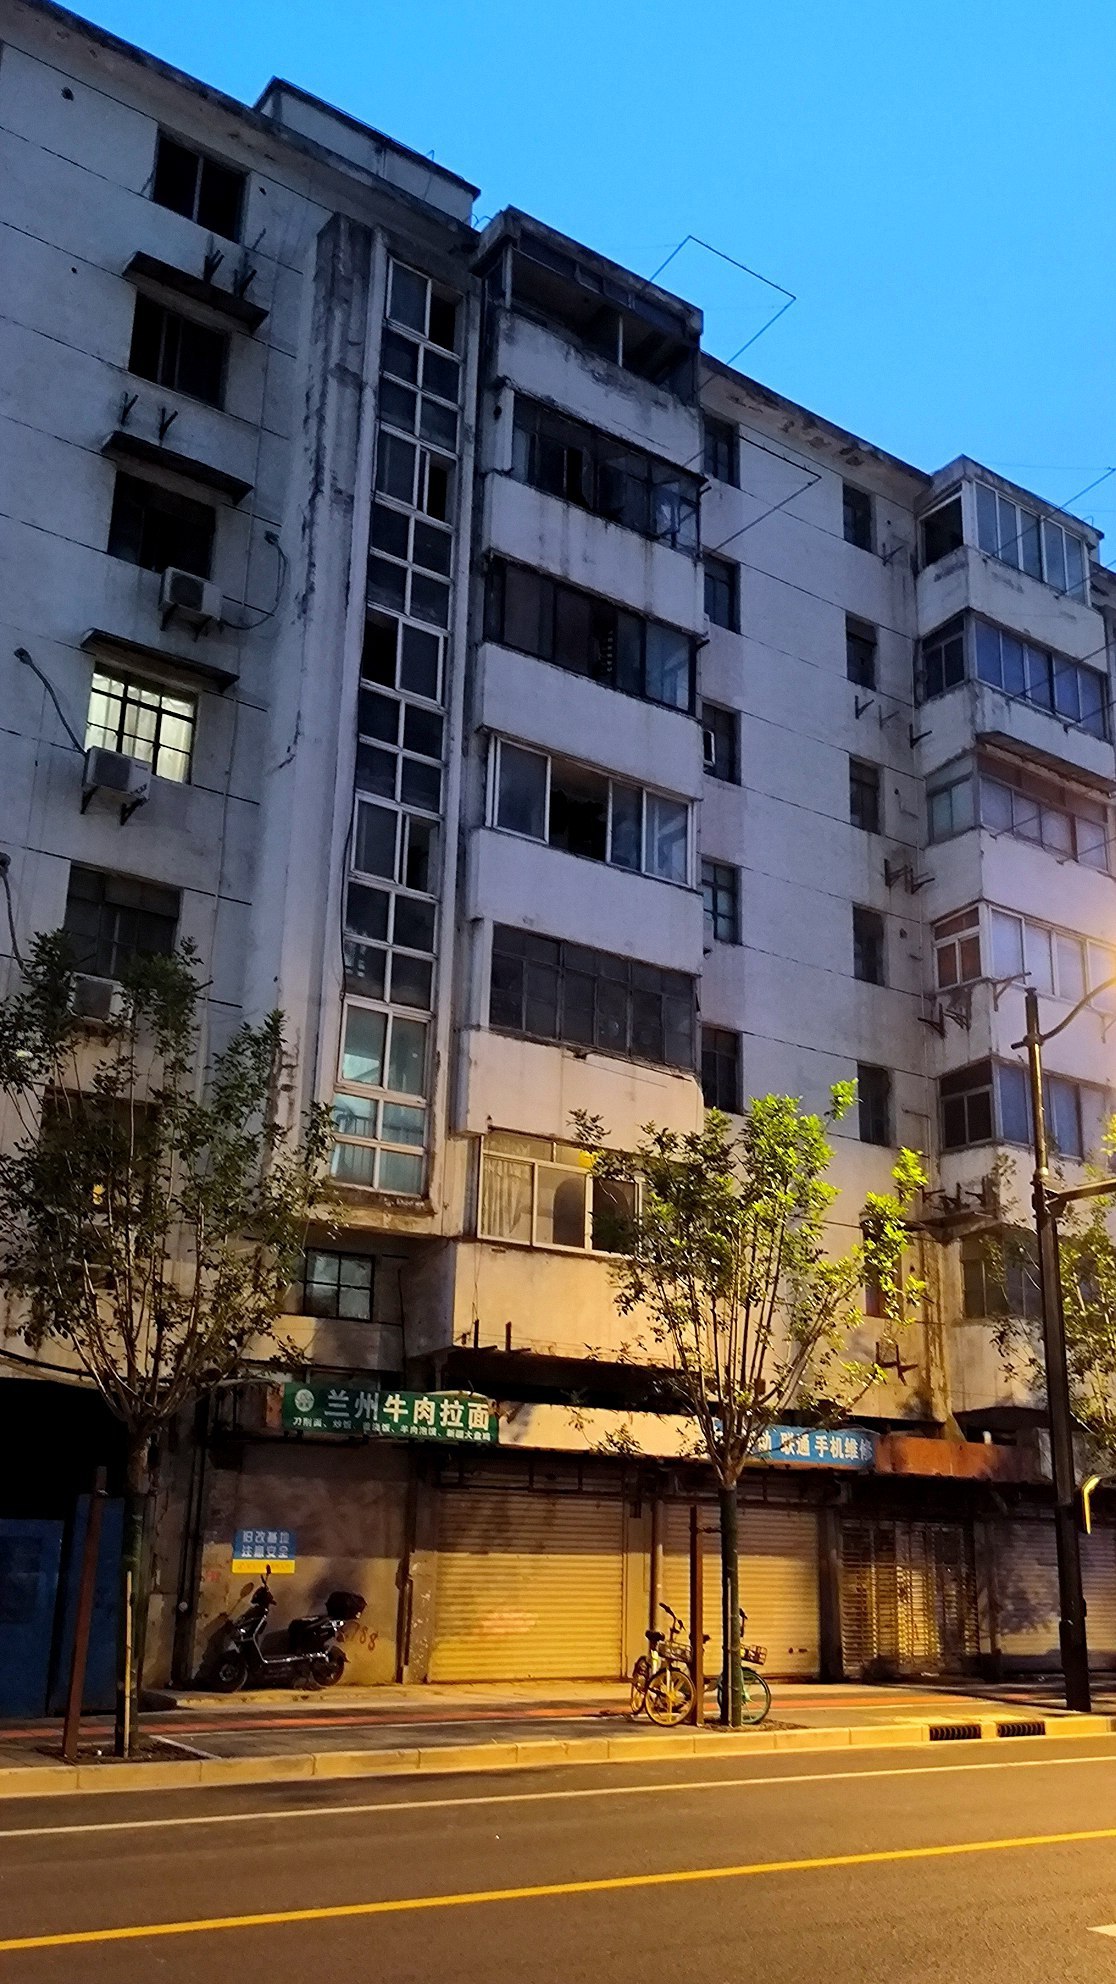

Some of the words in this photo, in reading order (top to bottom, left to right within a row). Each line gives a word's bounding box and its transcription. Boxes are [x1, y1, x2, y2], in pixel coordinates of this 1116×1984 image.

[324, 1389, 490, 1431] 兰州牛肉拉面
[780, 1431, 810, 1457] 联通
[815, 1434, 873, 1461] 手机维修
[242, 1530, 290, 1544] 旧改基地
[241, 1544, 289, 1559] 注意安全
